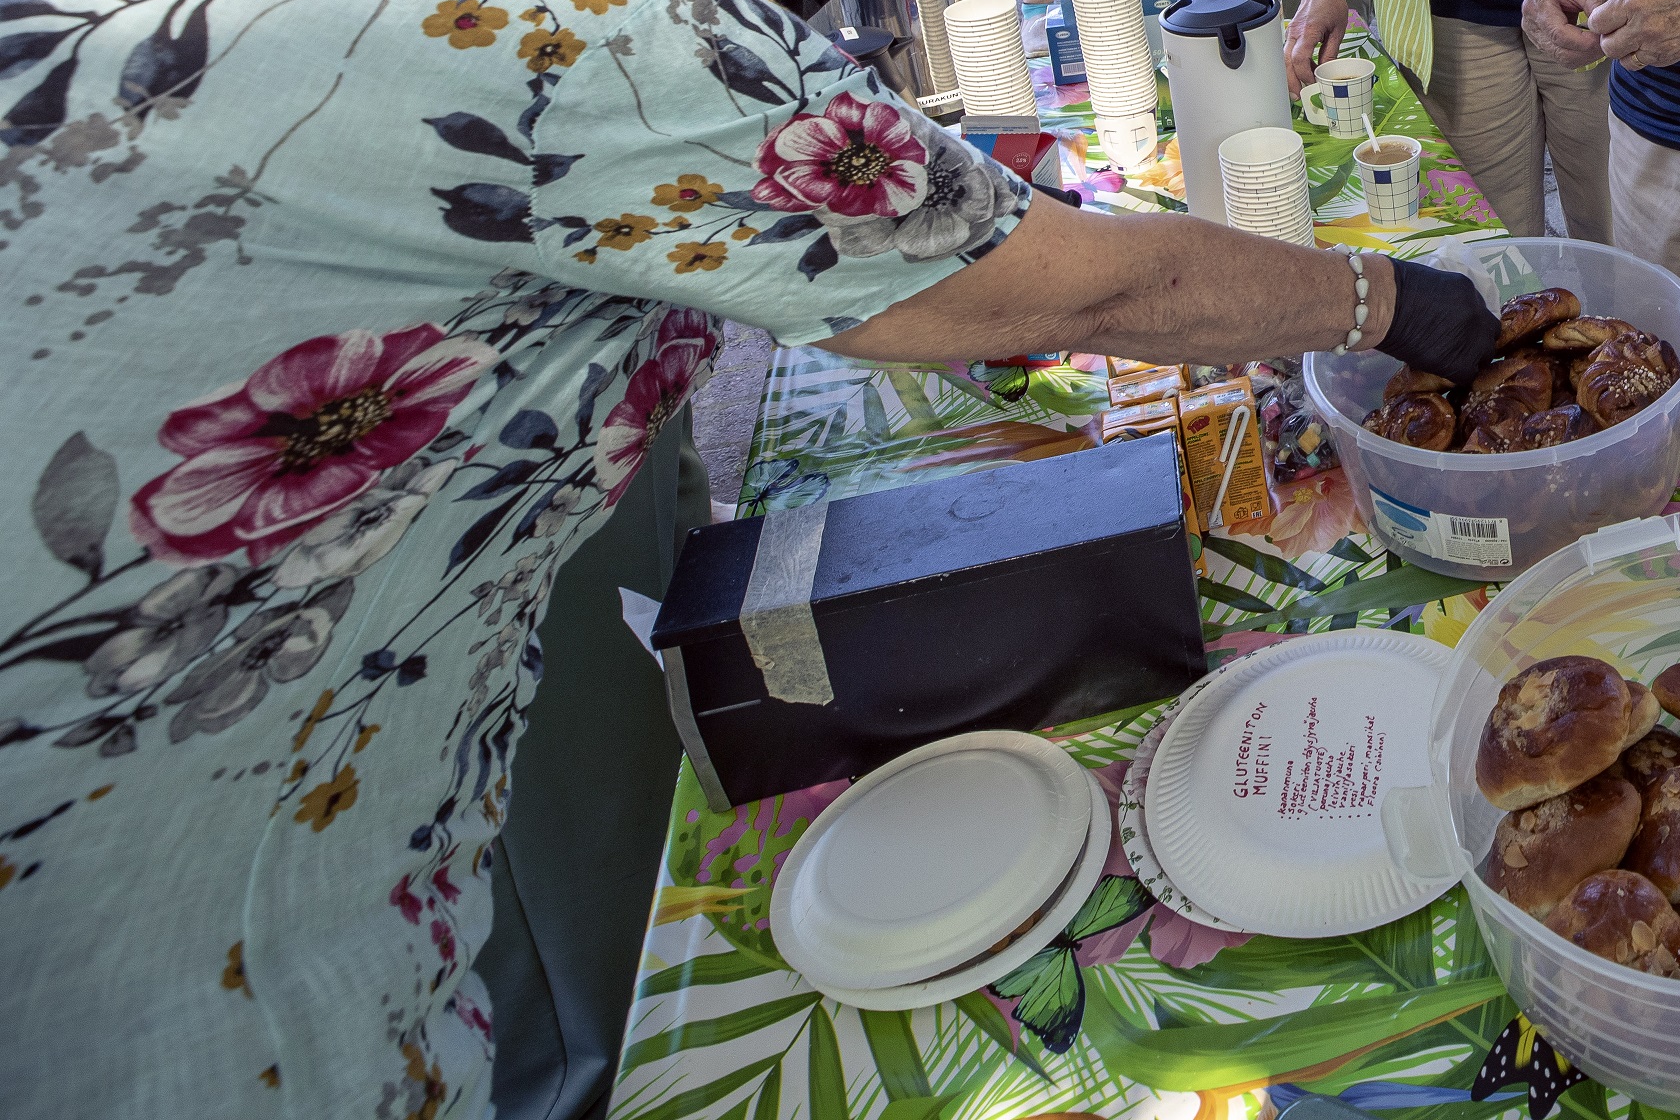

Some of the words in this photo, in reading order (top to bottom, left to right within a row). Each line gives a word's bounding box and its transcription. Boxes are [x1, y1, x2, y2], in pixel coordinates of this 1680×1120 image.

[1233, 702, 1268, 798] GLUTEENITON
[1252, 736, 1272, 795] MUFFINI
[1277, 760, 1294, 814] kananmuna
[1288, 782, 1301, 814] sokeri
